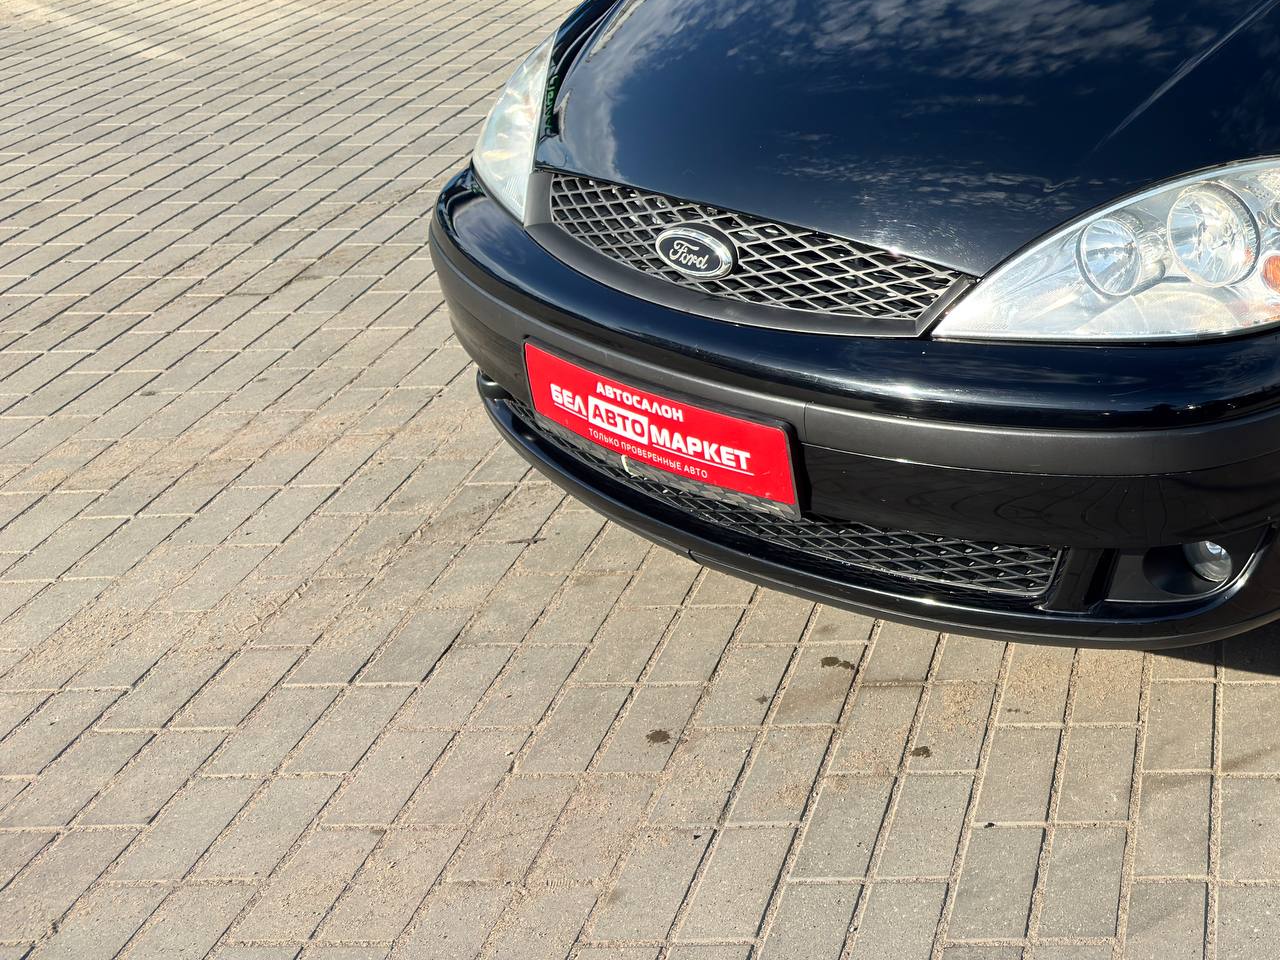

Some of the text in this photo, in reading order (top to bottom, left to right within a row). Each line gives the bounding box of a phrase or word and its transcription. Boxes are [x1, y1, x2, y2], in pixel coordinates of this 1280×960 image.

[669, 239, 710, 269] Ford
[596, 381, 684, 422] АВТОСАЛОН
[550, 383, 751, 470] БЕЛ АВТО МАРКЕТ
[588, 427, 708, 479] ТОЛЬКО ПРОВЕРЕННЫЕ АВТО
